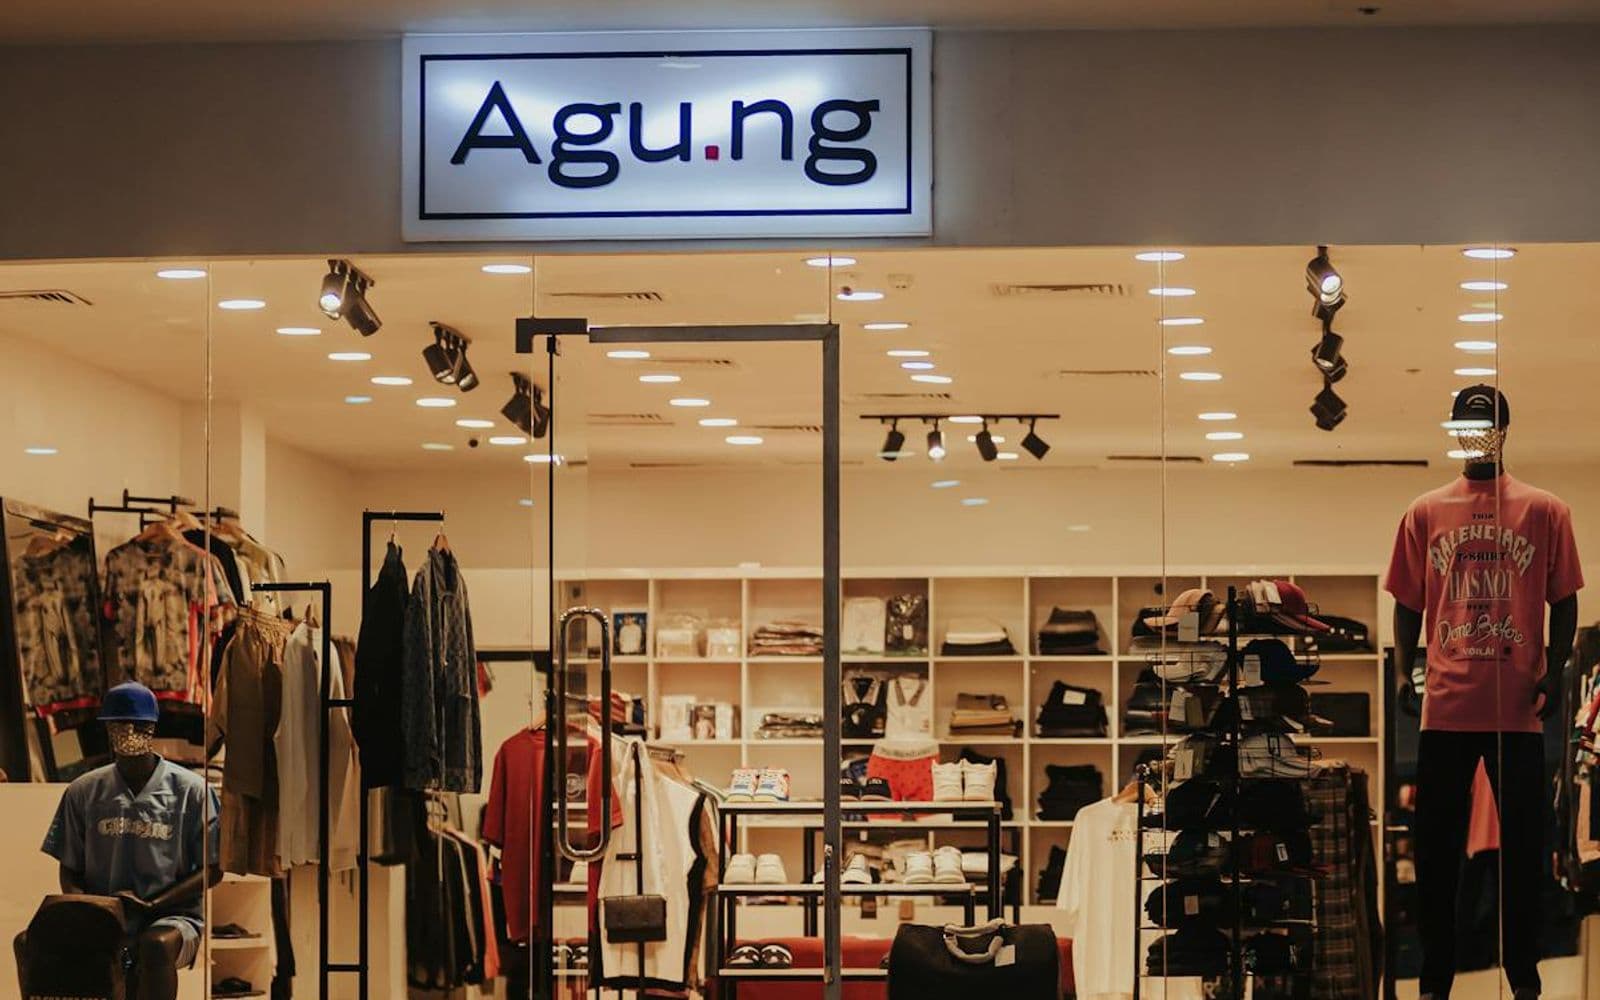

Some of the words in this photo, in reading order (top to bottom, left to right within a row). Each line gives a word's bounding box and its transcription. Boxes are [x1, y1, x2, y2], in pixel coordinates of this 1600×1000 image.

[450, 80, 880, 188] Agu.ng
[1483, 569, 1515, 599] NOT
[1438, 620, 1474, 649] Done
